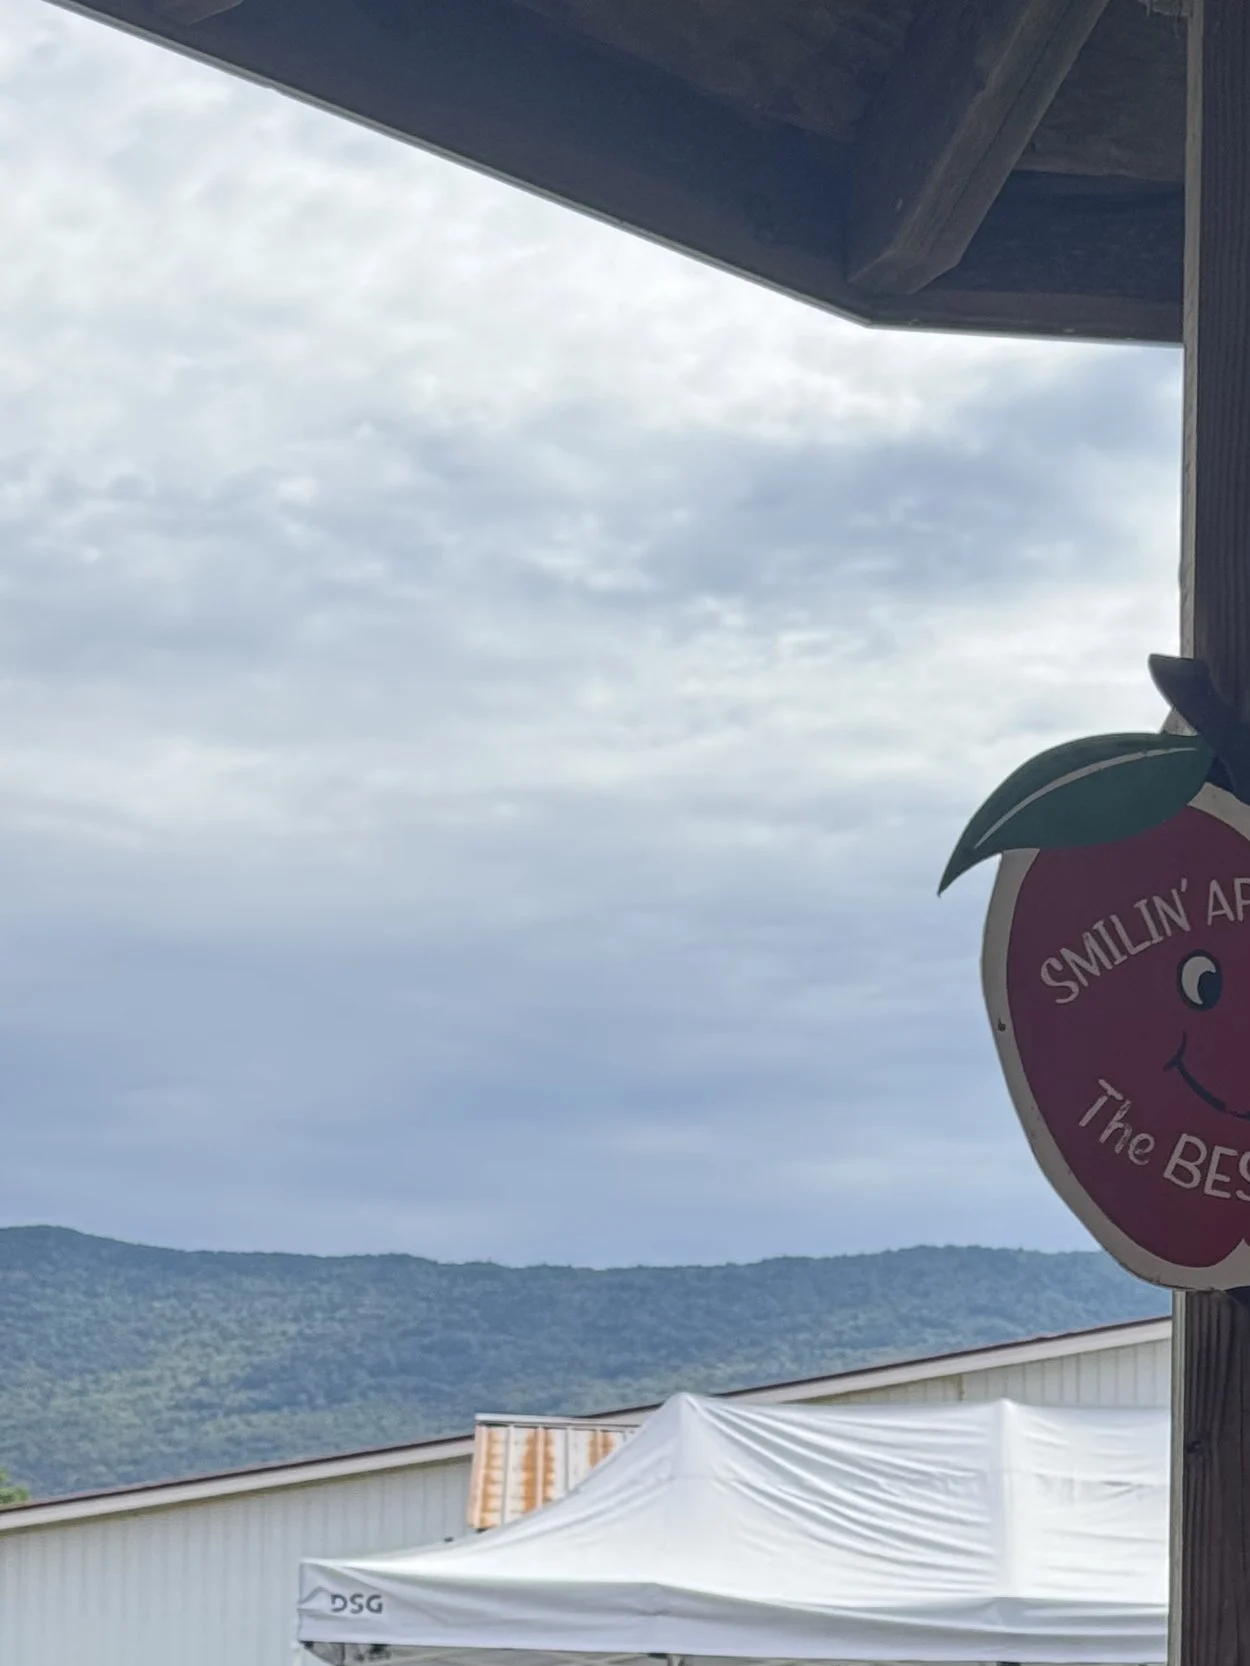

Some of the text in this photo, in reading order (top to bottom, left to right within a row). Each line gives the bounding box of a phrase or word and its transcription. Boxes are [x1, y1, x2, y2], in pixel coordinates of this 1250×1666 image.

[1040, 879, 1191, 1004] SMILIN'
[1078, 1079, 1155, 1165] The
[330, 1593, 383, 1614] DSG
